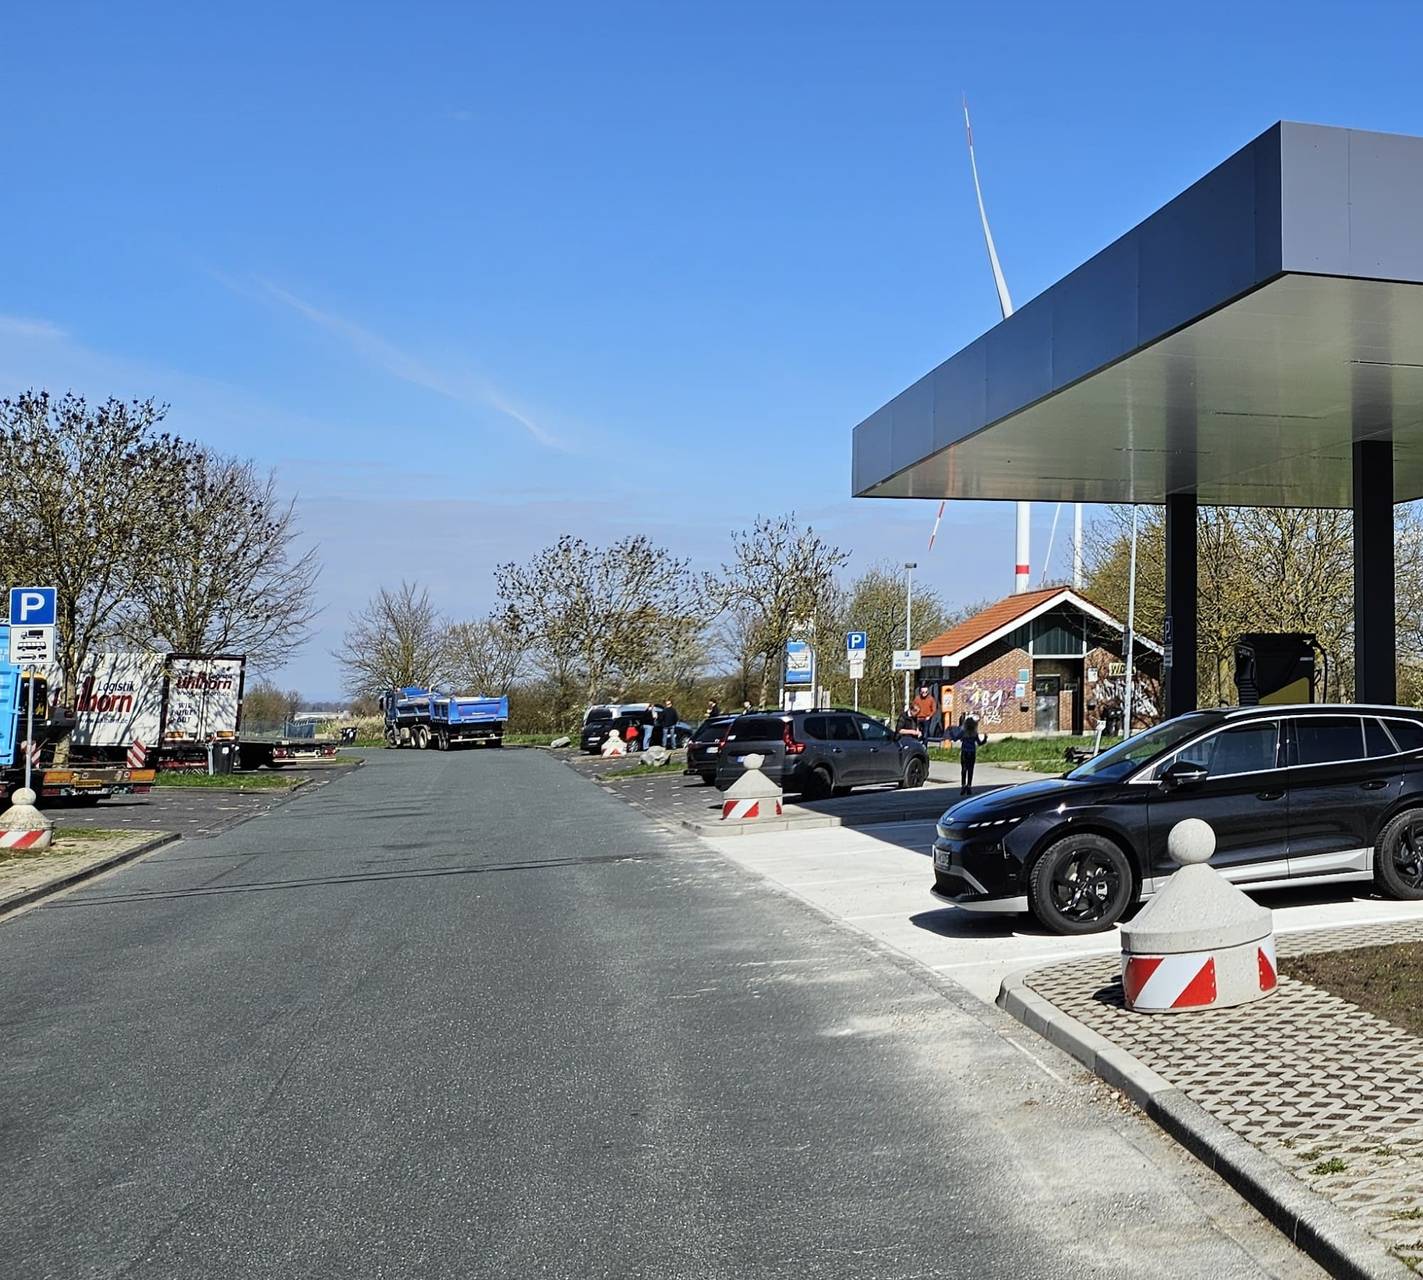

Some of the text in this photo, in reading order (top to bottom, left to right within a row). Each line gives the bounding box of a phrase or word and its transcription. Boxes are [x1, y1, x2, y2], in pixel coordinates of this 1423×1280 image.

[21, 592, 45, 621] P
[851, 634, 861, 648] P
[98, 681, 134, 694] Logistik
